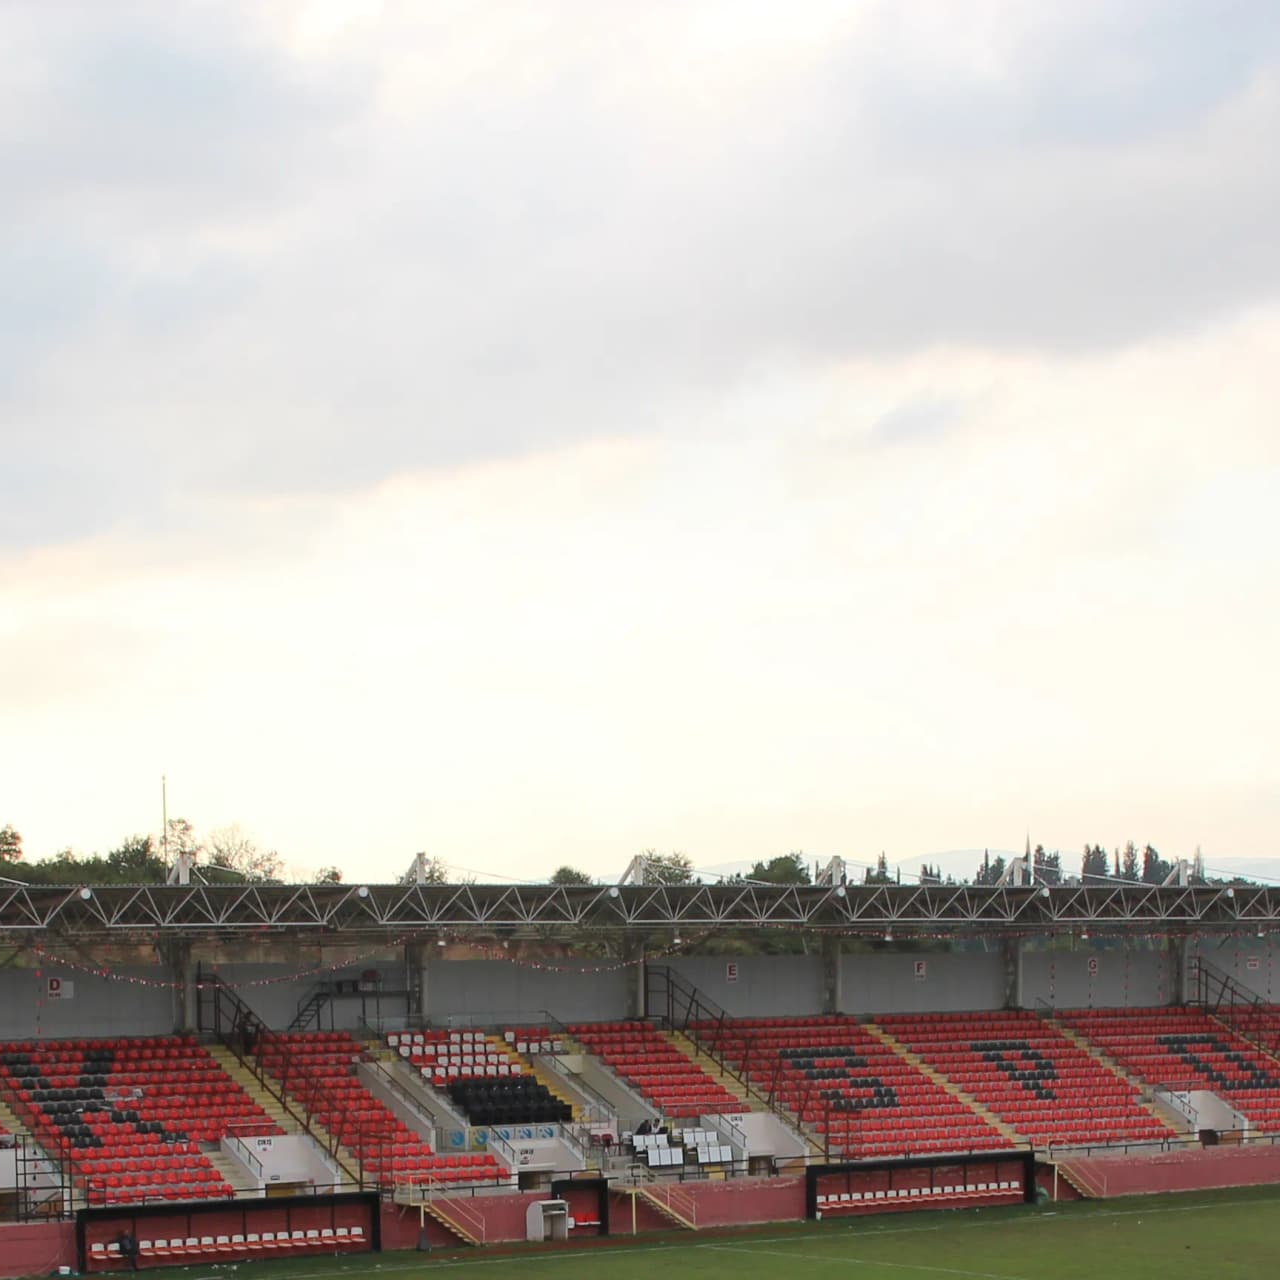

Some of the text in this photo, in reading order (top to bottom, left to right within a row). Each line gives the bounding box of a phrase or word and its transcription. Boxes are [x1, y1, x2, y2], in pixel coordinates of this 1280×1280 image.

[728, 964, 737, 976] E
[916, 962, 924, 974] F
[49, 978, 61, 991] D
